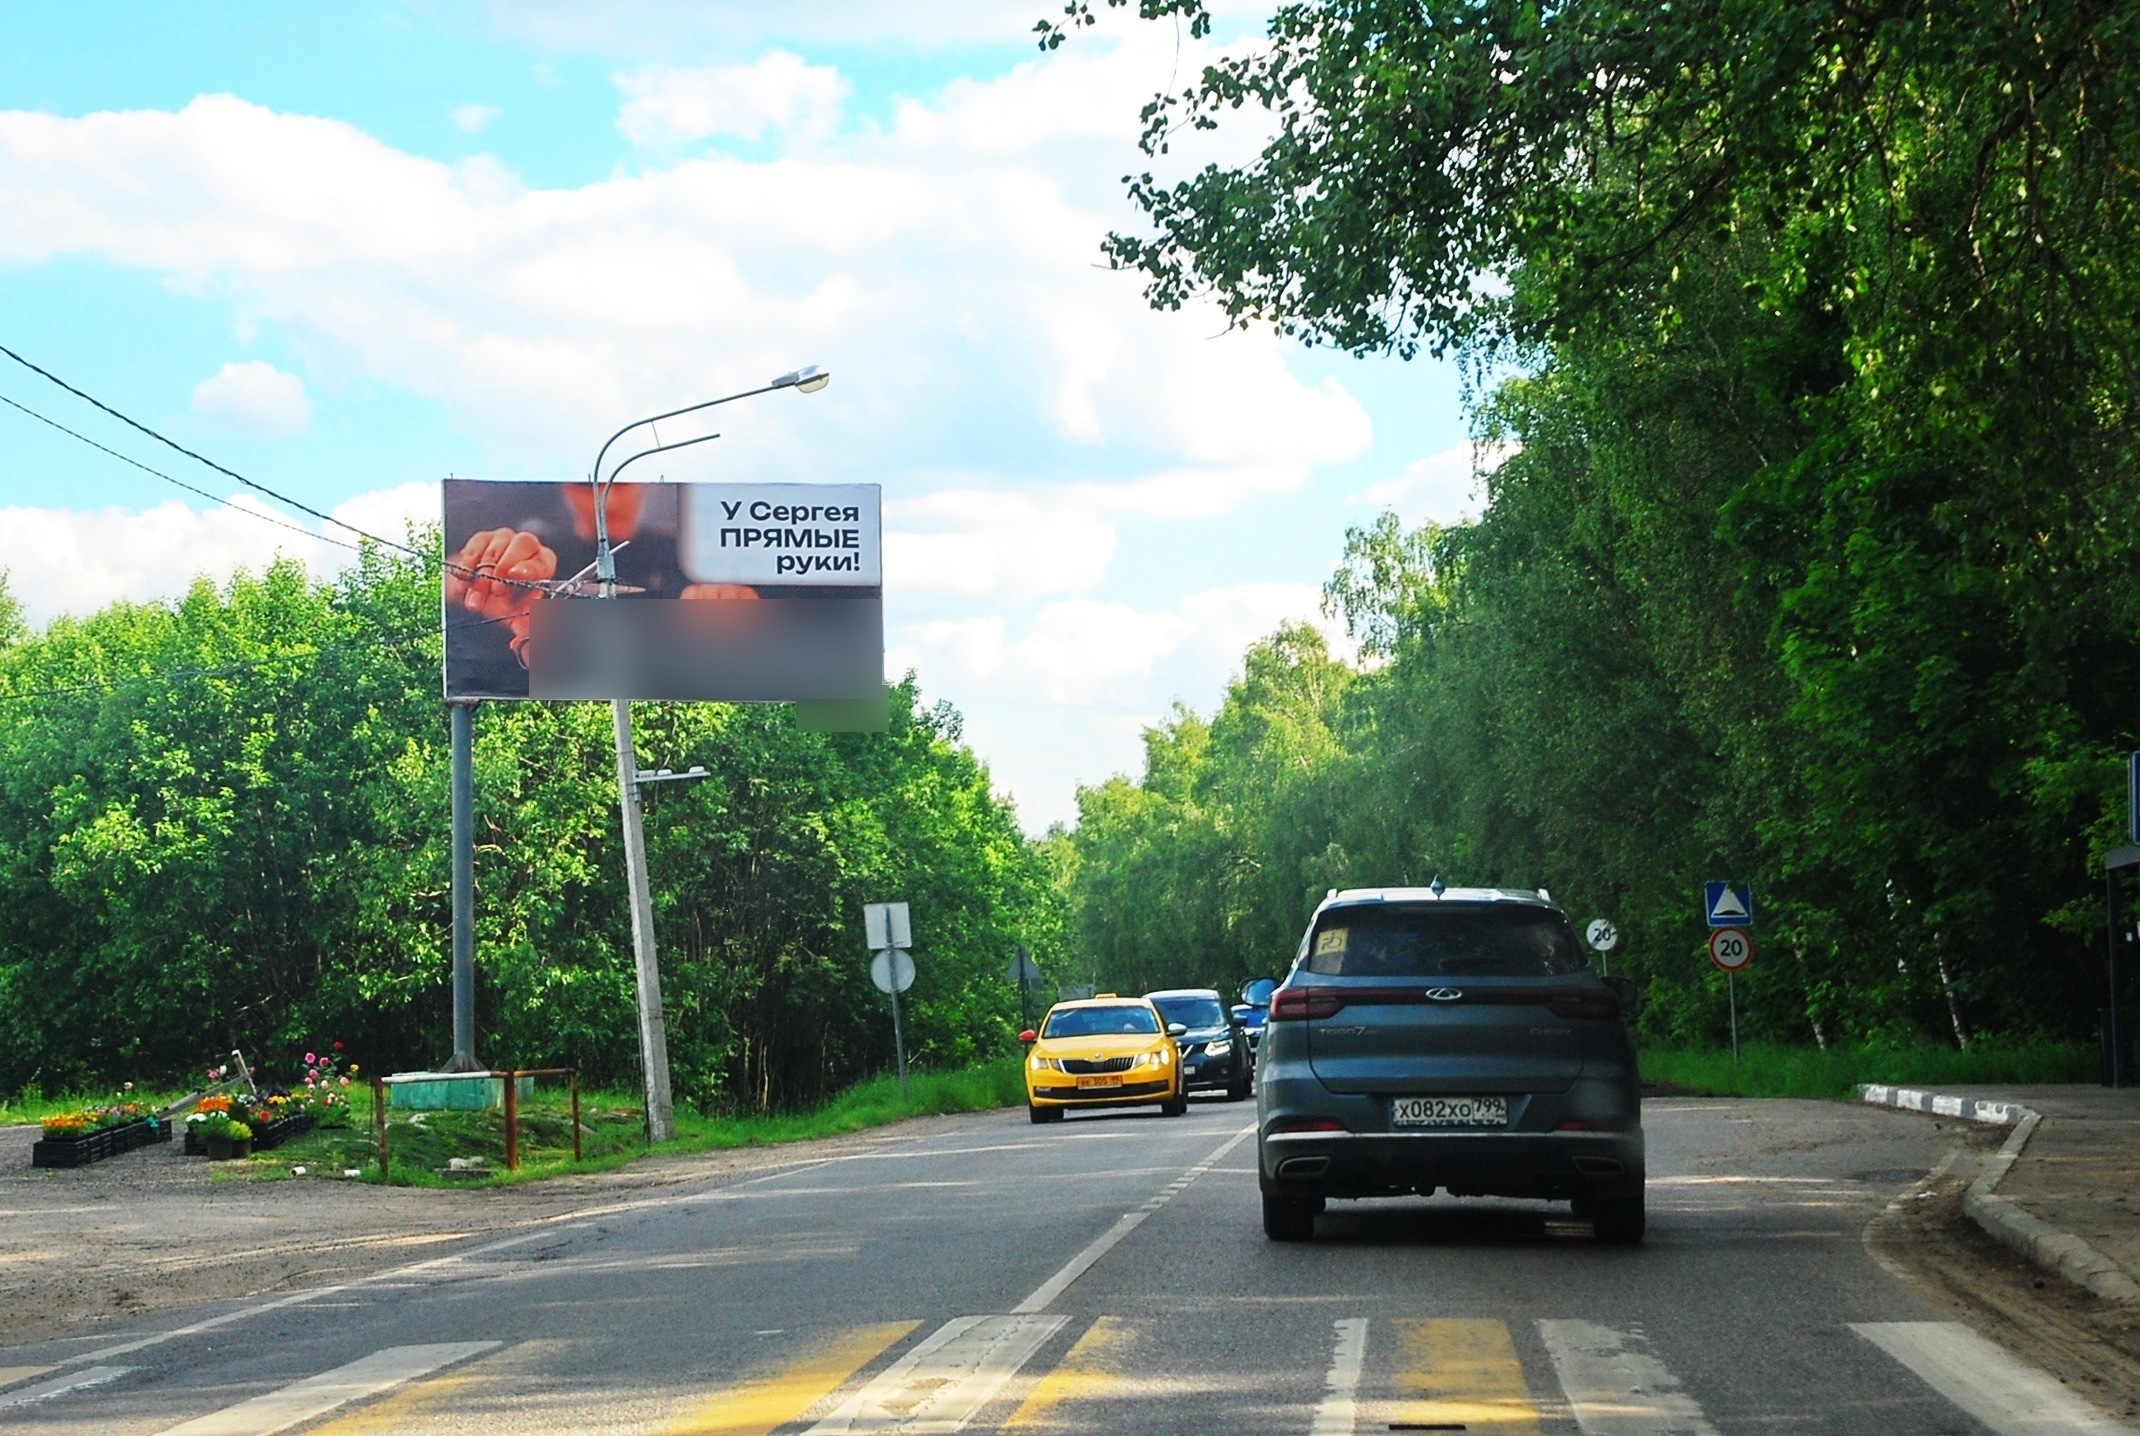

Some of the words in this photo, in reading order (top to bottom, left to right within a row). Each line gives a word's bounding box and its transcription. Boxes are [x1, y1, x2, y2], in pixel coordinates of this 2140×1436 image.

[720, 501, 742, 520] У
[750, 501, 859, 525] Сергея
[720, 528, 860, 549] ПРЯМЫЕ
[776, 552, 860, 575] руки!
[1594, 928, 1612, 942] 20
[1720, 939, 1743, 957] 20
